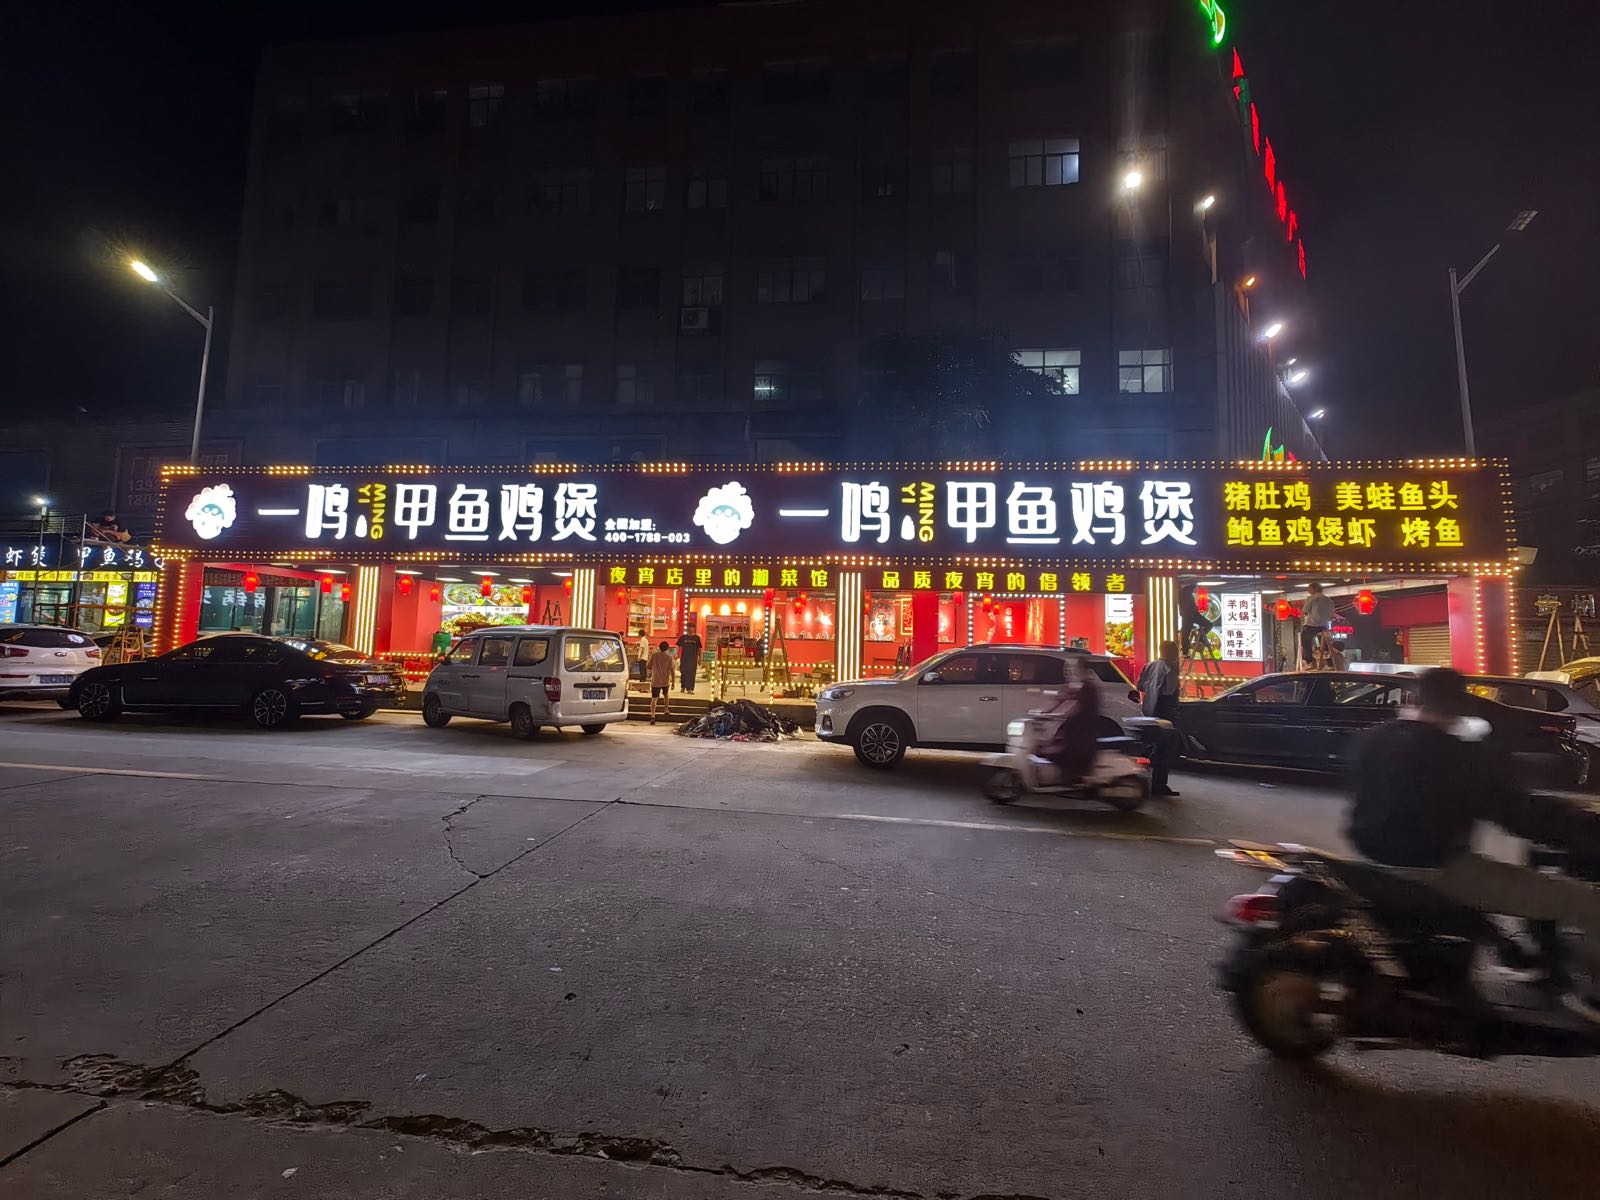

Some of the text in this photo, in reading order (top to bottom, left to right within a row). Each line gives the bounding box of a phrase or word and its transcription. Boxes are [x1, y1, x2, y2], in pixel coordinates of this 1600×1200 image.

[1224, 480, 1459, 511] 猪肚鸡 美蛙鱼头
[370, 484, 387, 540] MING
[919, 481, 935, 543] MING
[604, 532, 691, 543] 400-1788-003
[1227, 517, 1464, 548] 鲍鱼鸡煲虾 烤鱼
[610, 566, 828, 588] 夜宵店里的湘菜馆
[882, 570, 1126, 592] 品质夜宵的倡领者
[1227, 599, 1249, 610] 羊肉
[1228, 611, 1249, 622] 火锅
